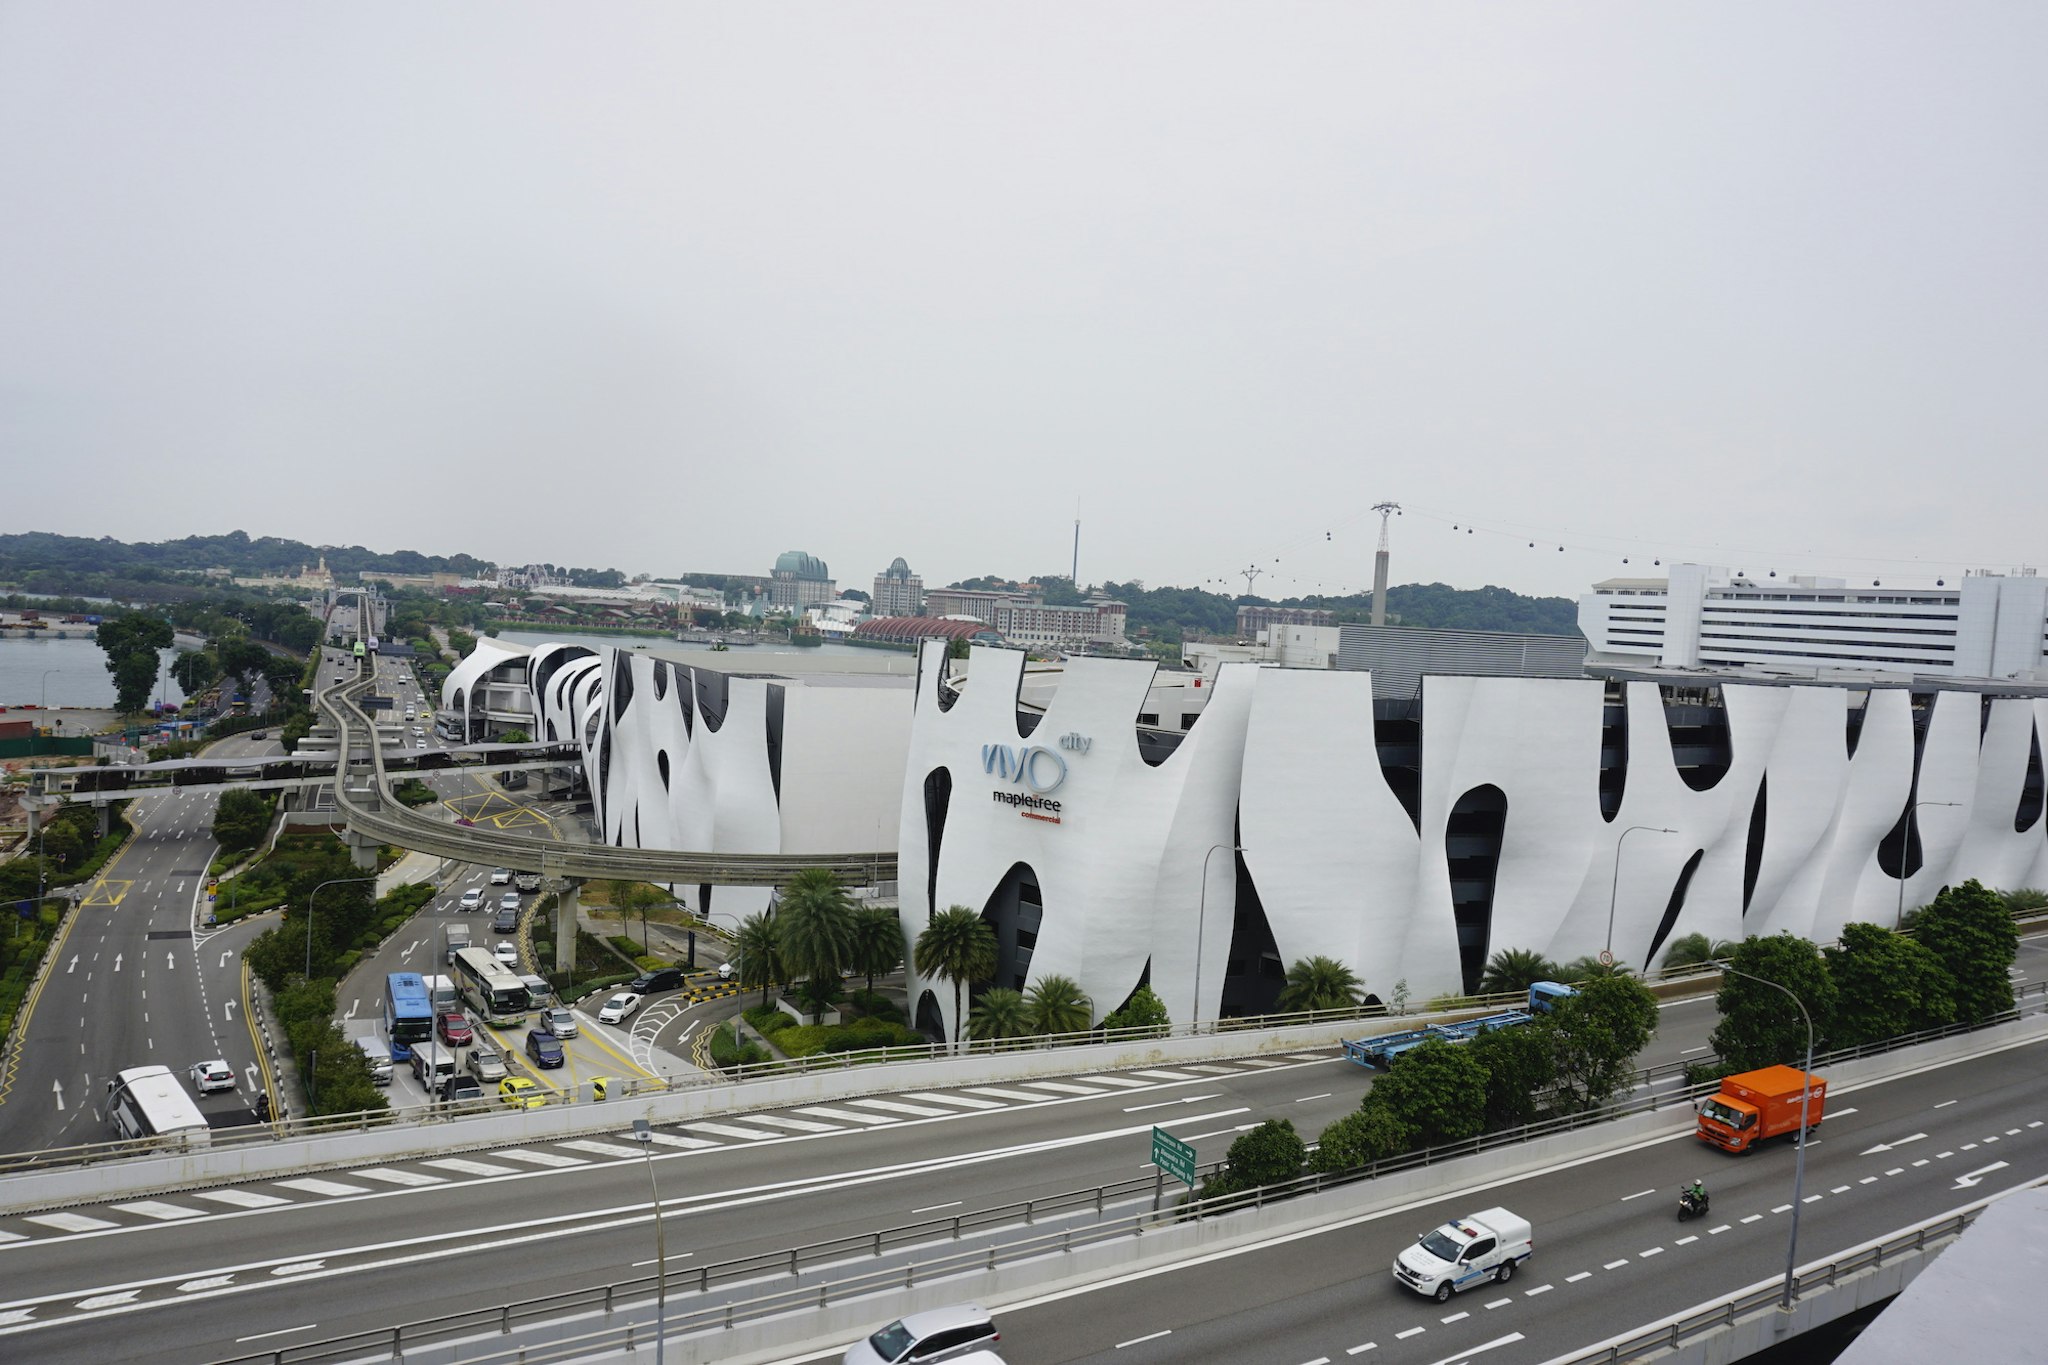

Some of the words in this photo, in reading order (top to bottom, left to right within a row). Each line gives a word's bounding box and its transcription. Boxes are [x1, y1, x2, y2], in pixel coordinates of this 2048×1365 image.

[1058, 732, 1093, 756] city
[993, 791, 1062, 812] mapletree
[1021, 811, 1061, 824] commercial
